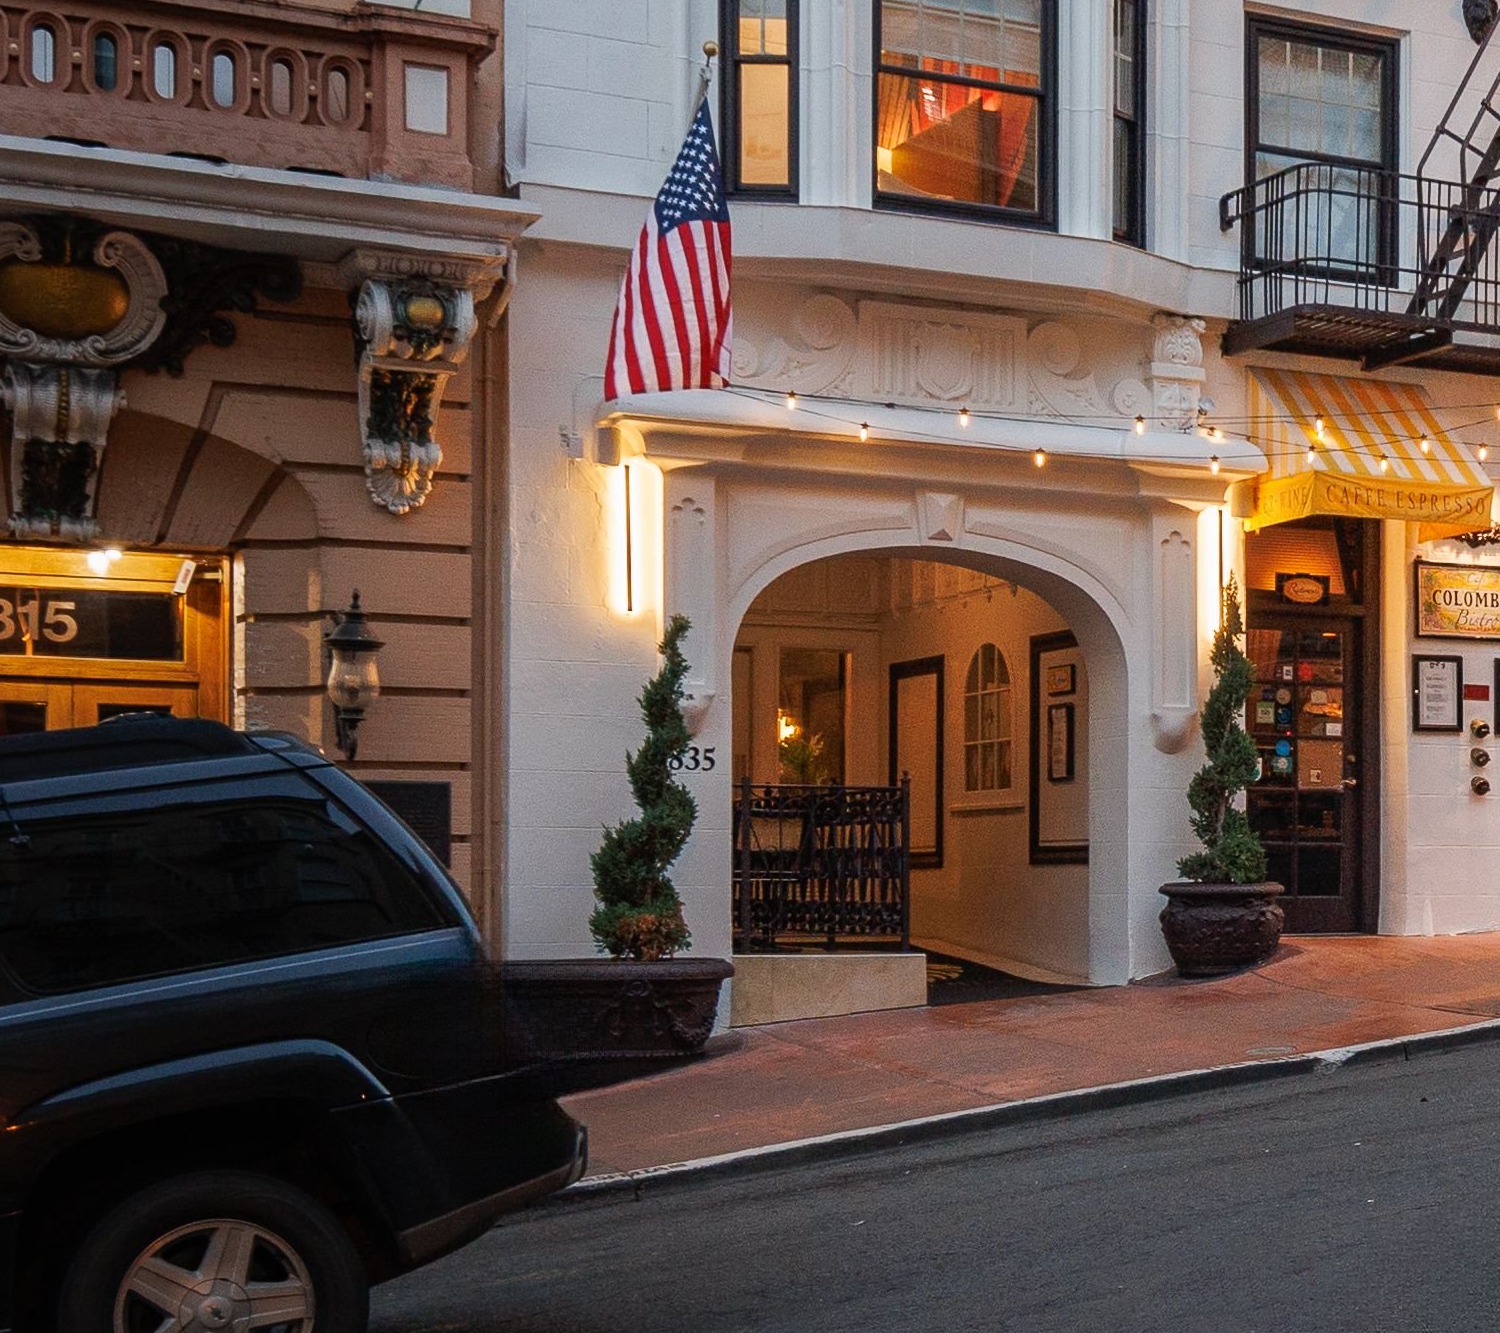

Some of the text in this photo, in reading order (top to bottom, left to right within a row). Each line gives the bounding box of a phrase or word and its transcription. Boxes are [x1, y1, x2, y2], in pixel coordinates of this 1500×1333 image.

[1326, 484, 1487, 515] CAFFE ESPRESSO
[1455, 608, 1500, 628] Bistro
